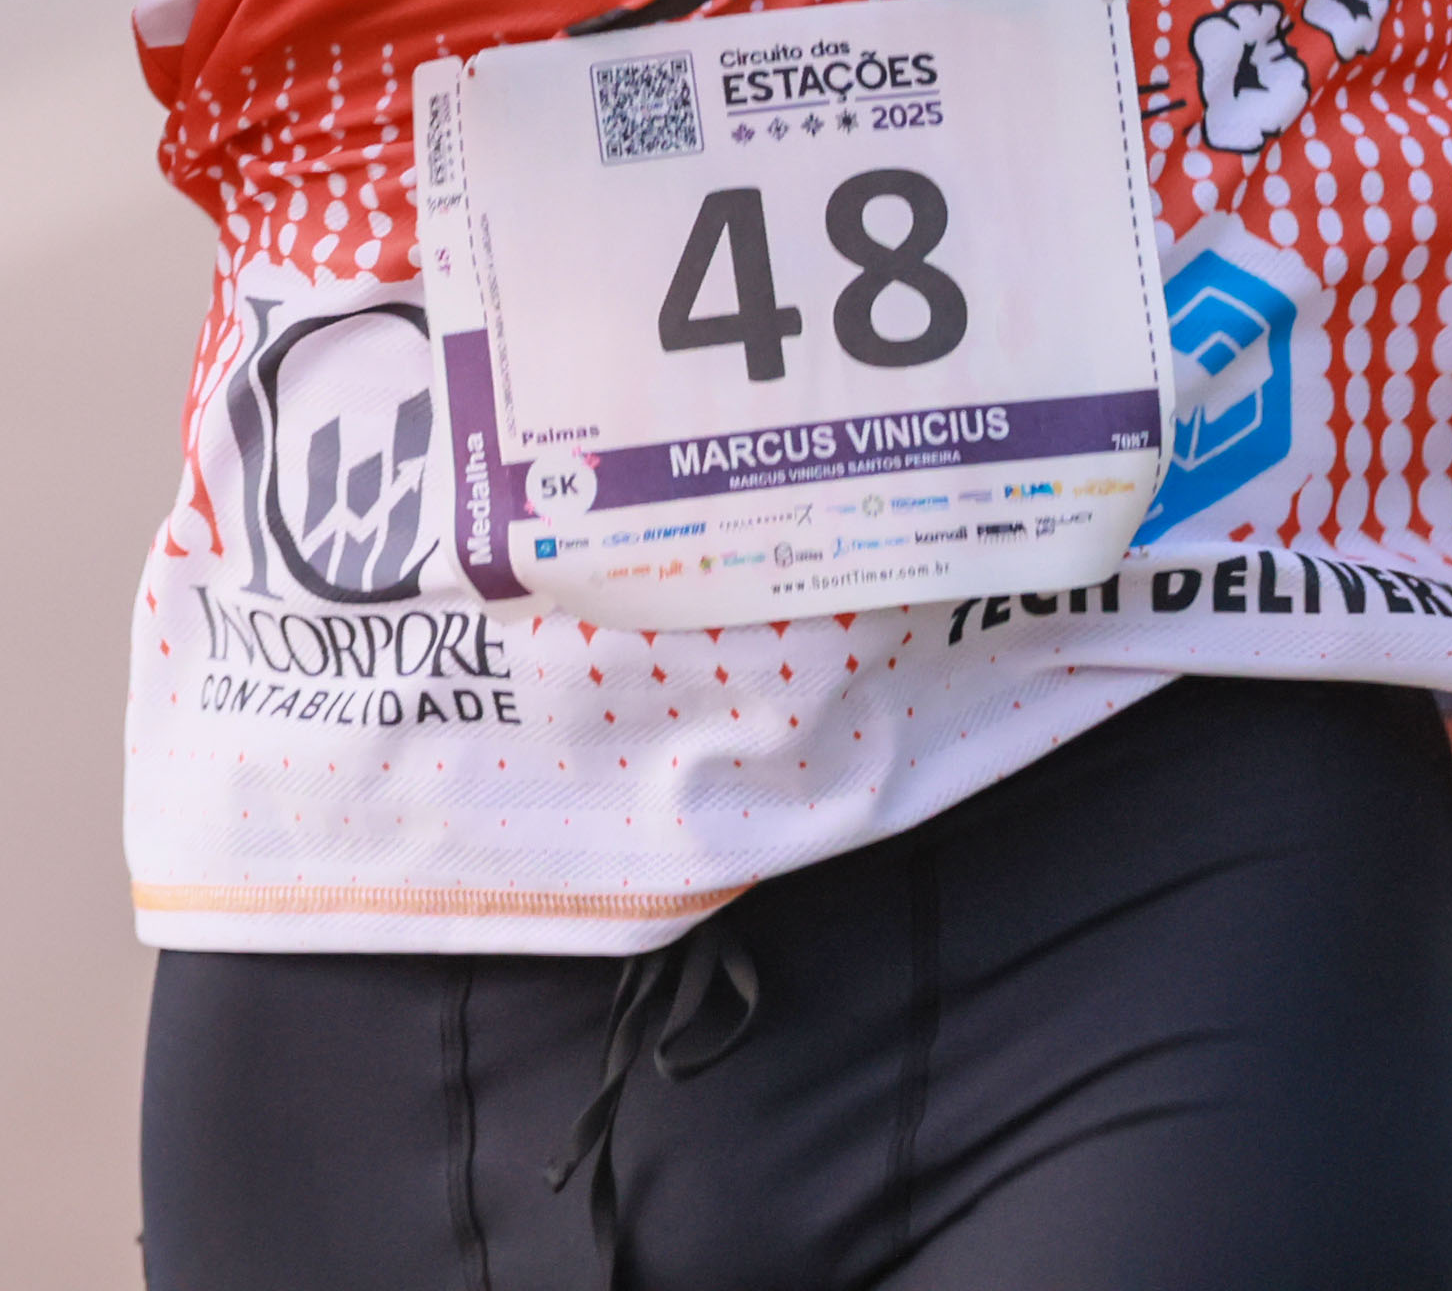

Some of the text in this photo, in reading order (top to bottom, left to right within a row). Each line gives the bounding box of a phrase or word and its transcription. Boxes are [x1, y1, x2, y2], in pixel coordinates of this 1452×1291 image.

[719, 38, 850, 68] Circuito das
[721, 50, 938, 103] ESTAÇÕES
[871, 100, 944, 132] 2025
[657, 167, 969, 382] 48
[521, 423, 601, 448] Palmas
[668, 406, 1010, 479] MARCUS VINICIUS
[540, 472, 579, 500] 5K
[728, 448, 962, 491] MARCUS VINICIUS SANTOS PEREIRA
[465, 431, 493, 567] Medalha
[190, 585, 511, 681] INCORPORE
[201, 674, 522, 726] CONTABILIDADE
